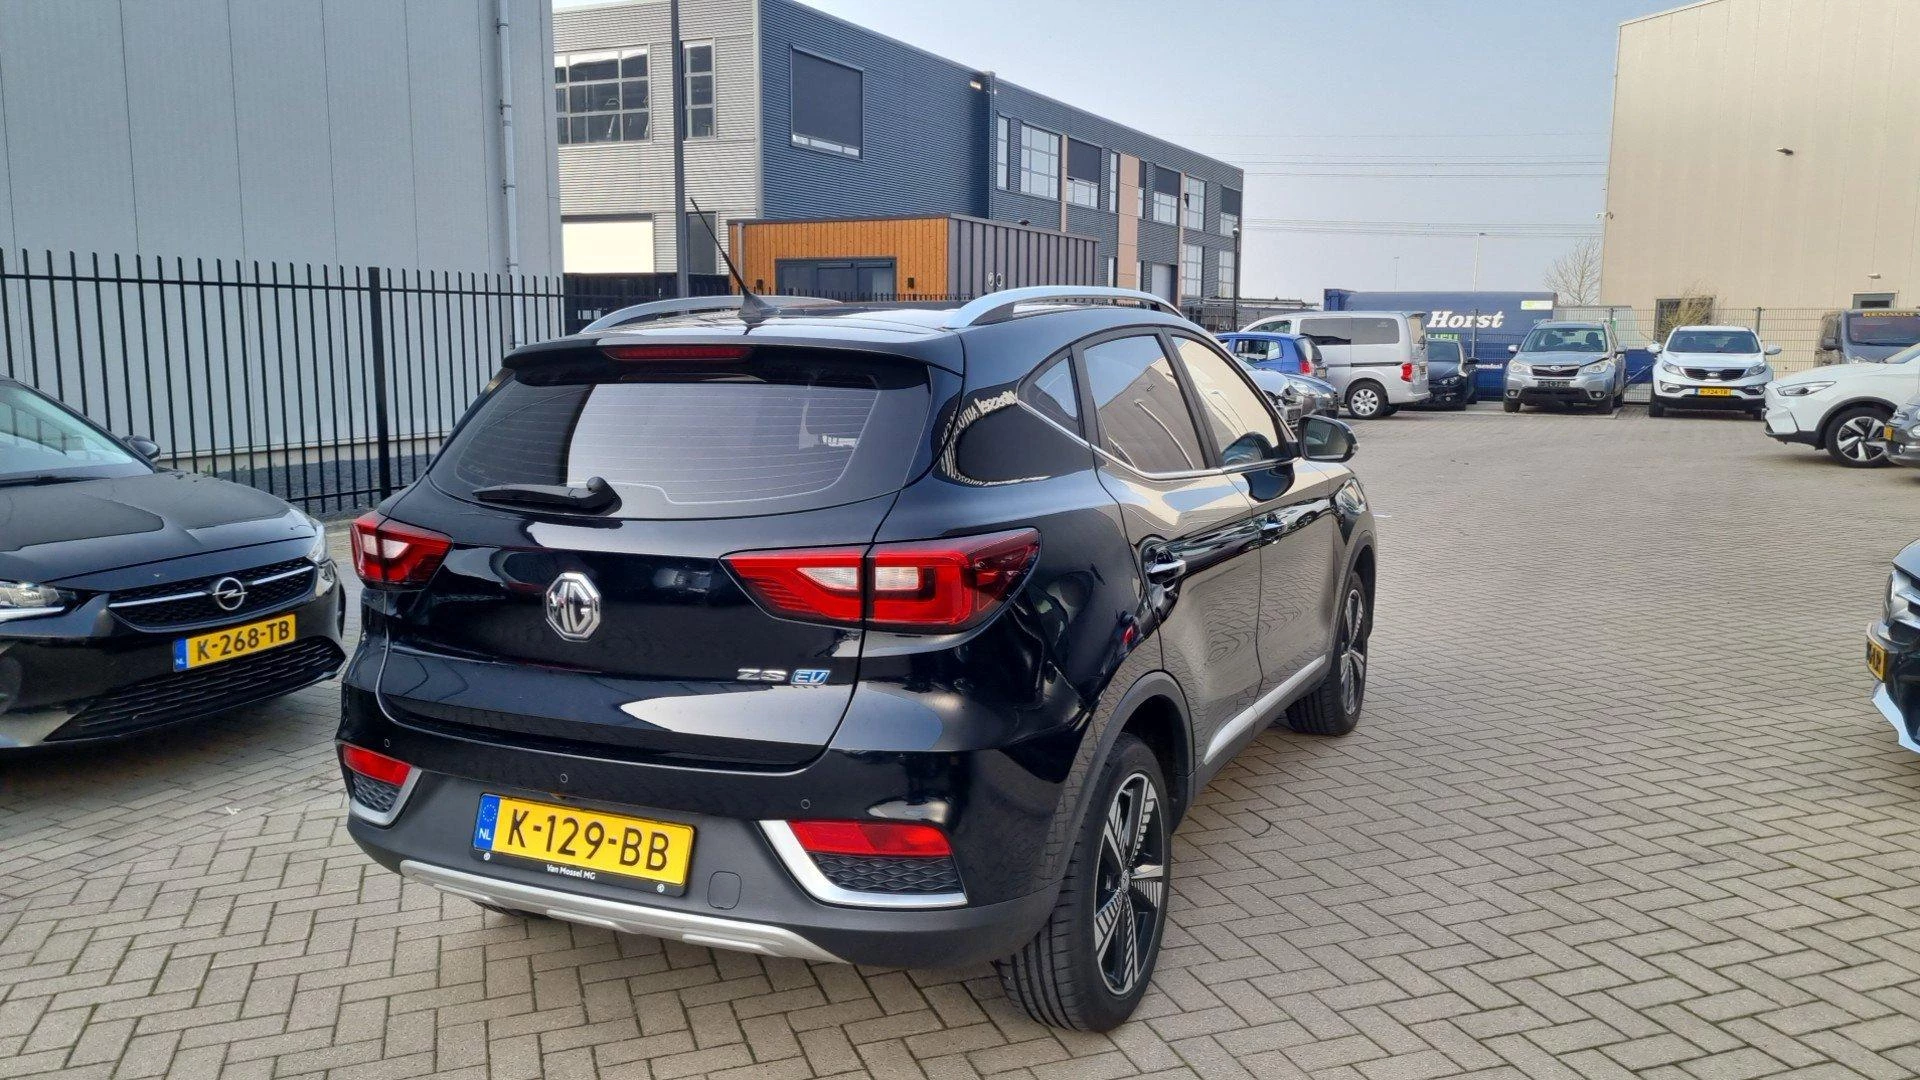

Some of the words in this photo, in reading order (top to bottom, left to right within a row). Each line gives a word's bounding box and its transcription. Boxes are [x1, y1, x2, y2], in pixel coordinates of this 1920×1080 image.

[1426, 310, 1504, 328] Horst
[196, 620, 290, 662] K-268-TB
[737, 668, 787, 682] ZS
[792, 670, 829, 684] EV
[478, 827, 493, 842] NL
[506, 808, 670, 873] K-129-BB
[546, 863, 560, 874] Van
[559, 866, 583, 878] Mossel
[583, 870, 596, 880] MG
